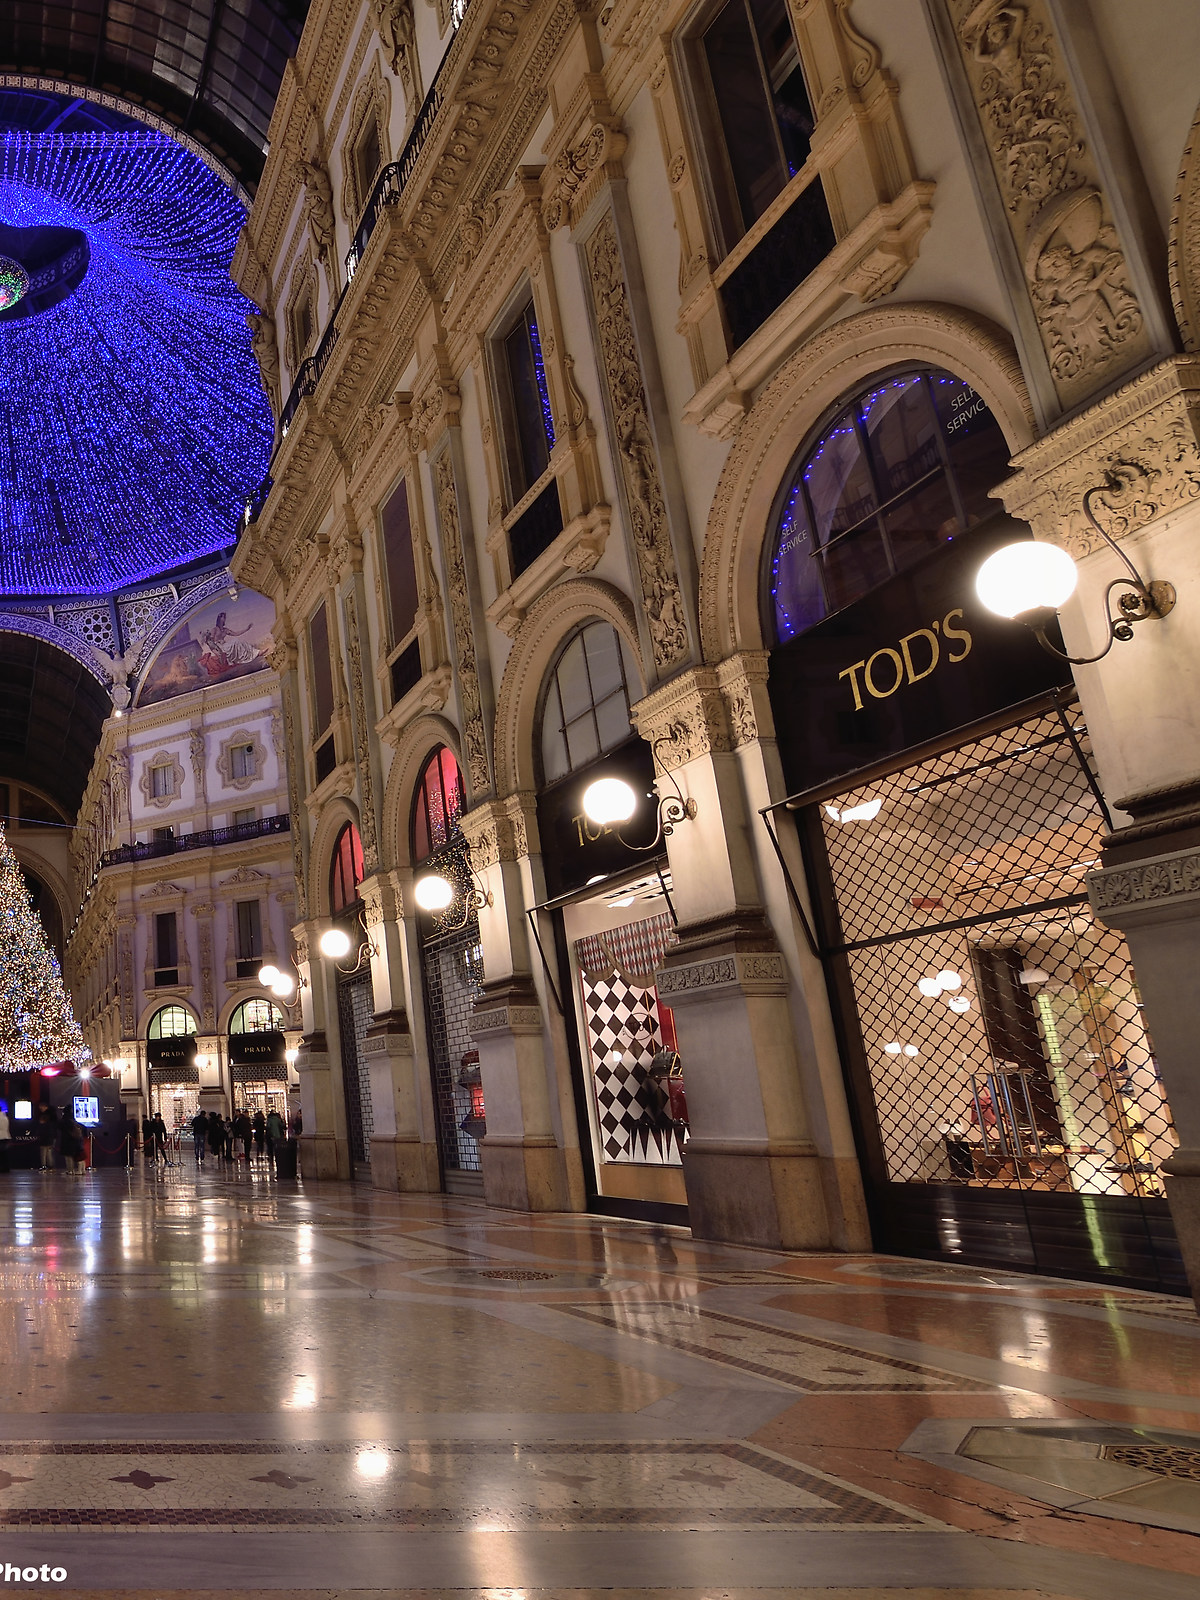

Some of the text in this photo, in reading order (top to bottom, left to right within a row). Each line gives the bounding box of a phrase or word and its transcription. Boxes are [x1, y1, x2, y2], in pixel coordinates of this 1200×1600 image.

[947, 398, 988, 434] SERVIC
[779, 530, 808, 557] SERVICE
[782, 520, 798, 539] SELF
[838, 608, 972, 711] TOD'S
